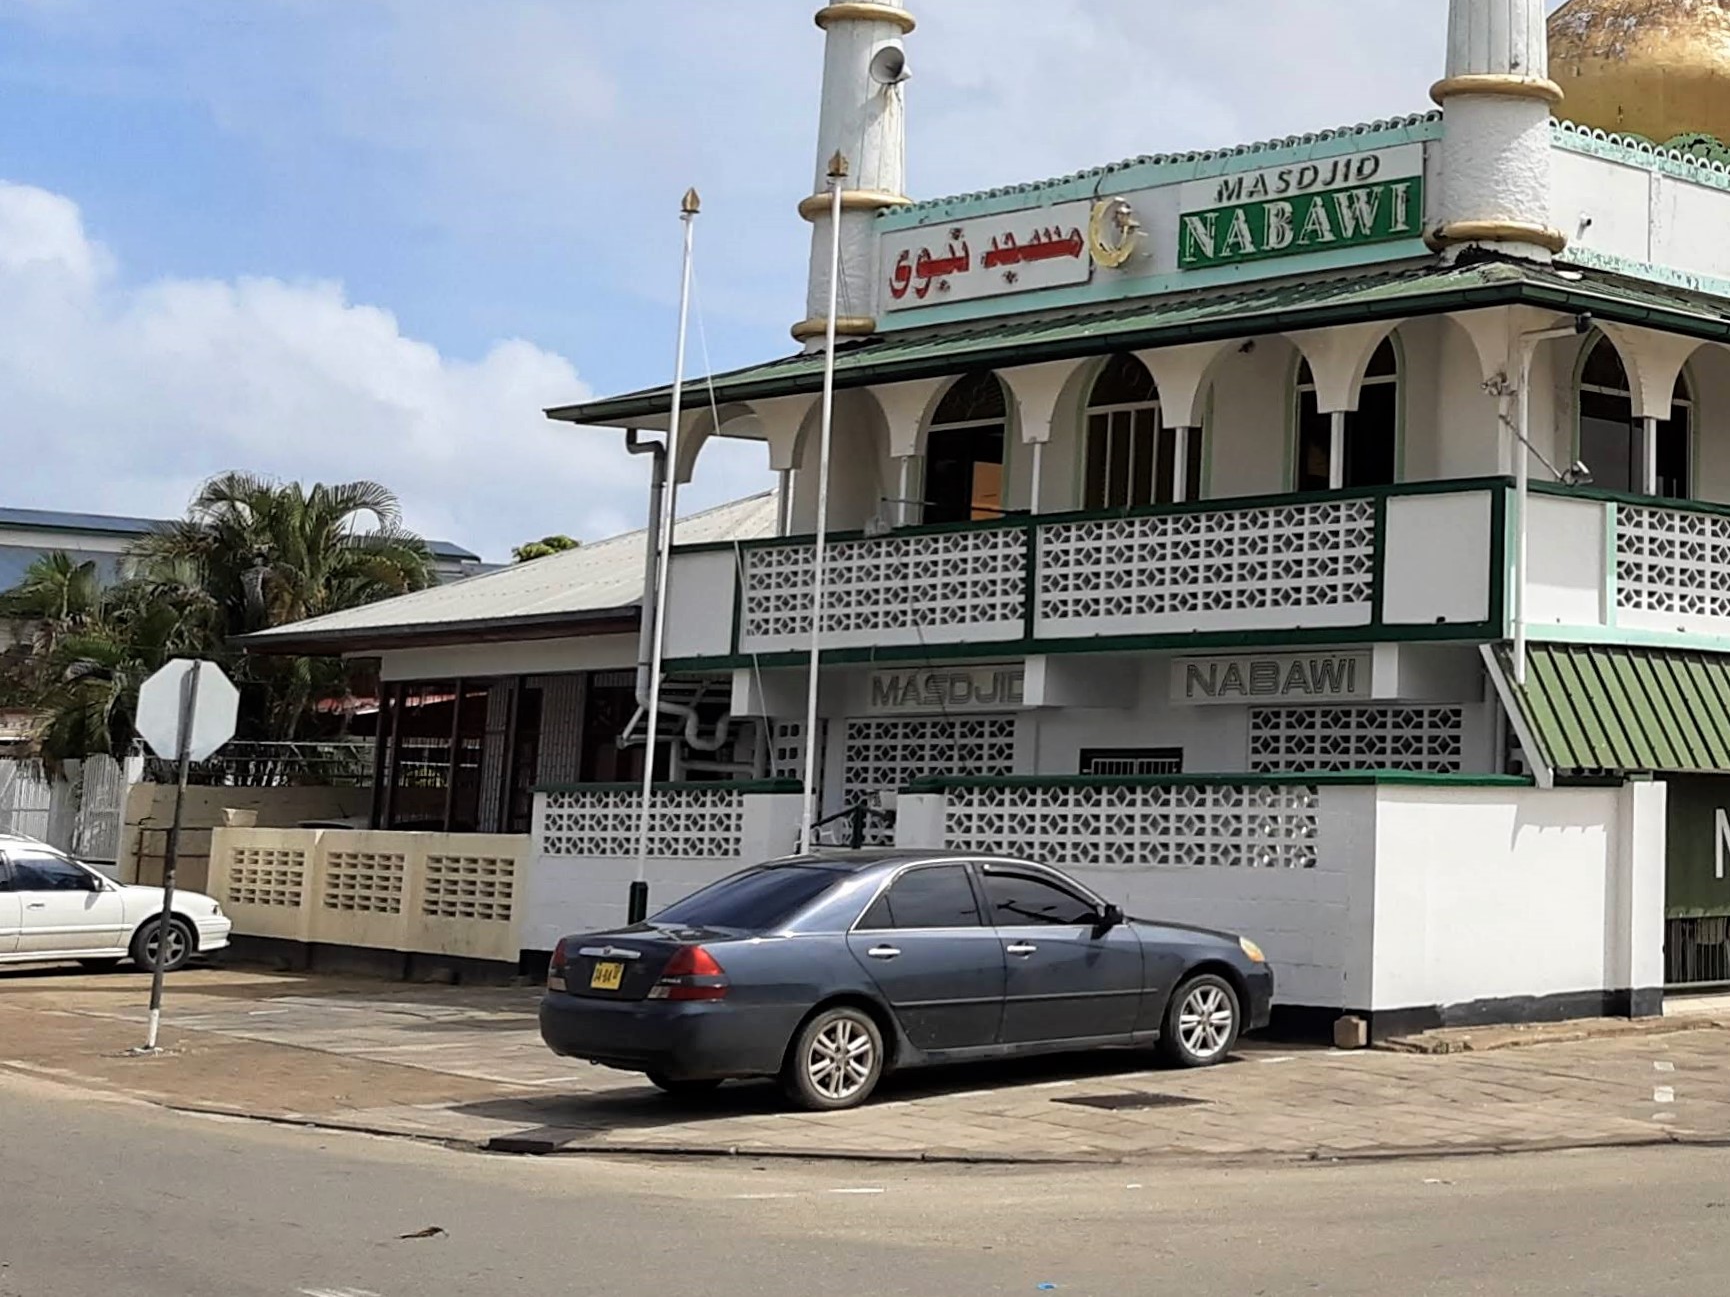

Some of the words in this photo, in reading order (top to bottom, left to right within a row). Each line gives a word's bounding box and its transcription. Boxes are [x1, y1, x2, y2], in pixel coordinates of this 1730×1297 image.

[1215, 154, 1380, 203] MASDJID
[1182, 182, 1411, 262] NABAWI
[979, 225, 1084, 285] مسجد
[1186, 658, 1356, 697] NABAWI
